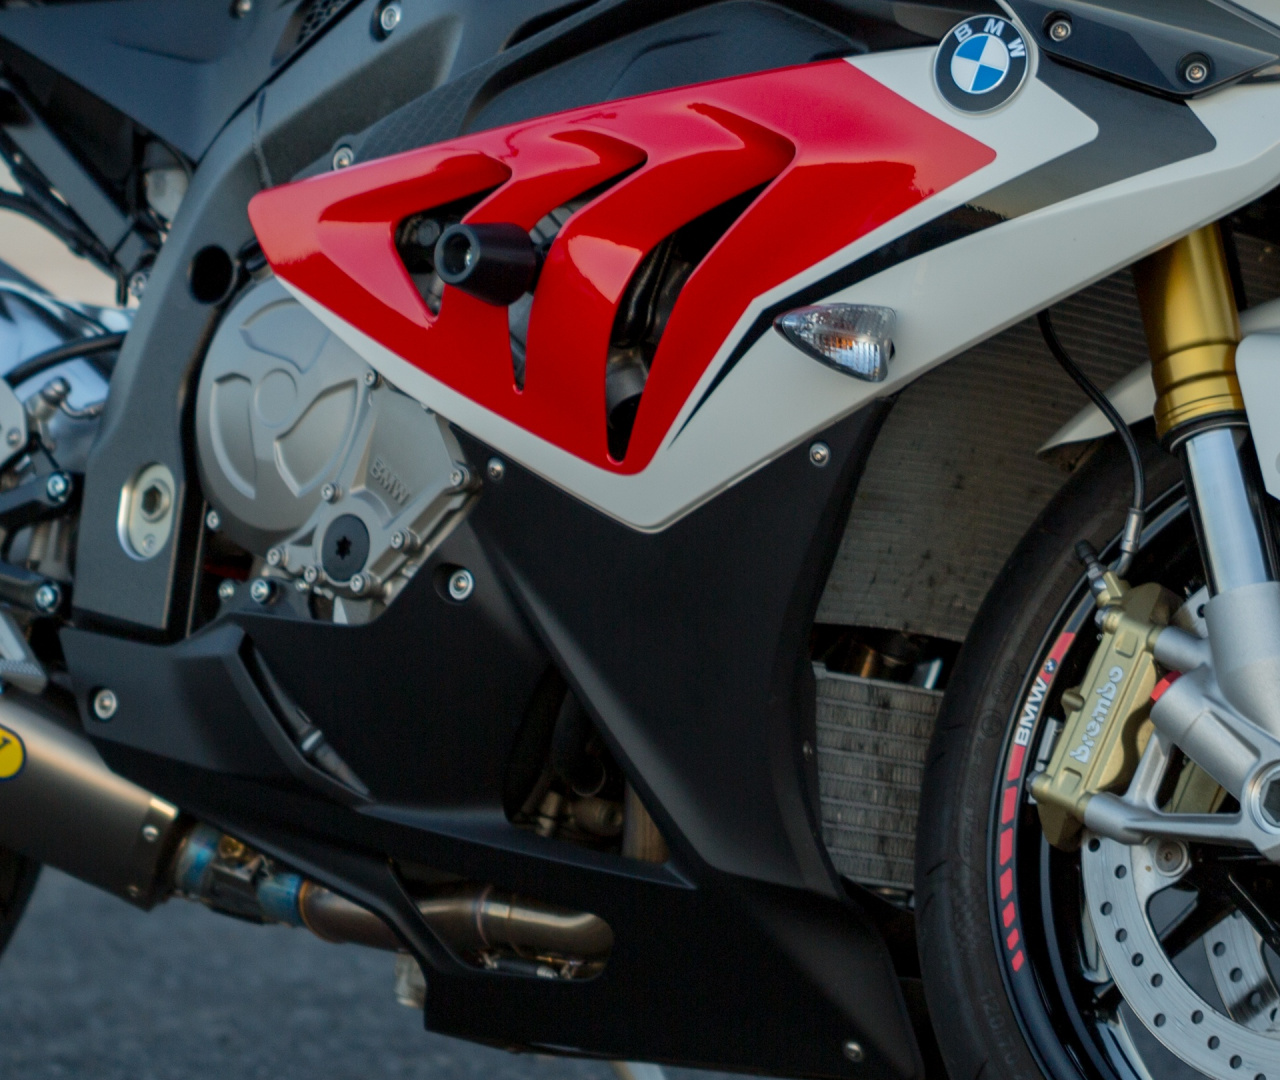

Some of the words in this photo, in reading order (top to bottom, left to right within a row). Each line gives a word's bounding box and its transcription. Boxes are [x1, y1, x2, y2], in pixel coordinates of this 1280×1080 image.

[953, 18, 1026, 58] BMW
[370, 457, 410, 506] BMW
[1014, 676, 1047, 746] BMW
[1070, 666, 1123, 763] brembo
